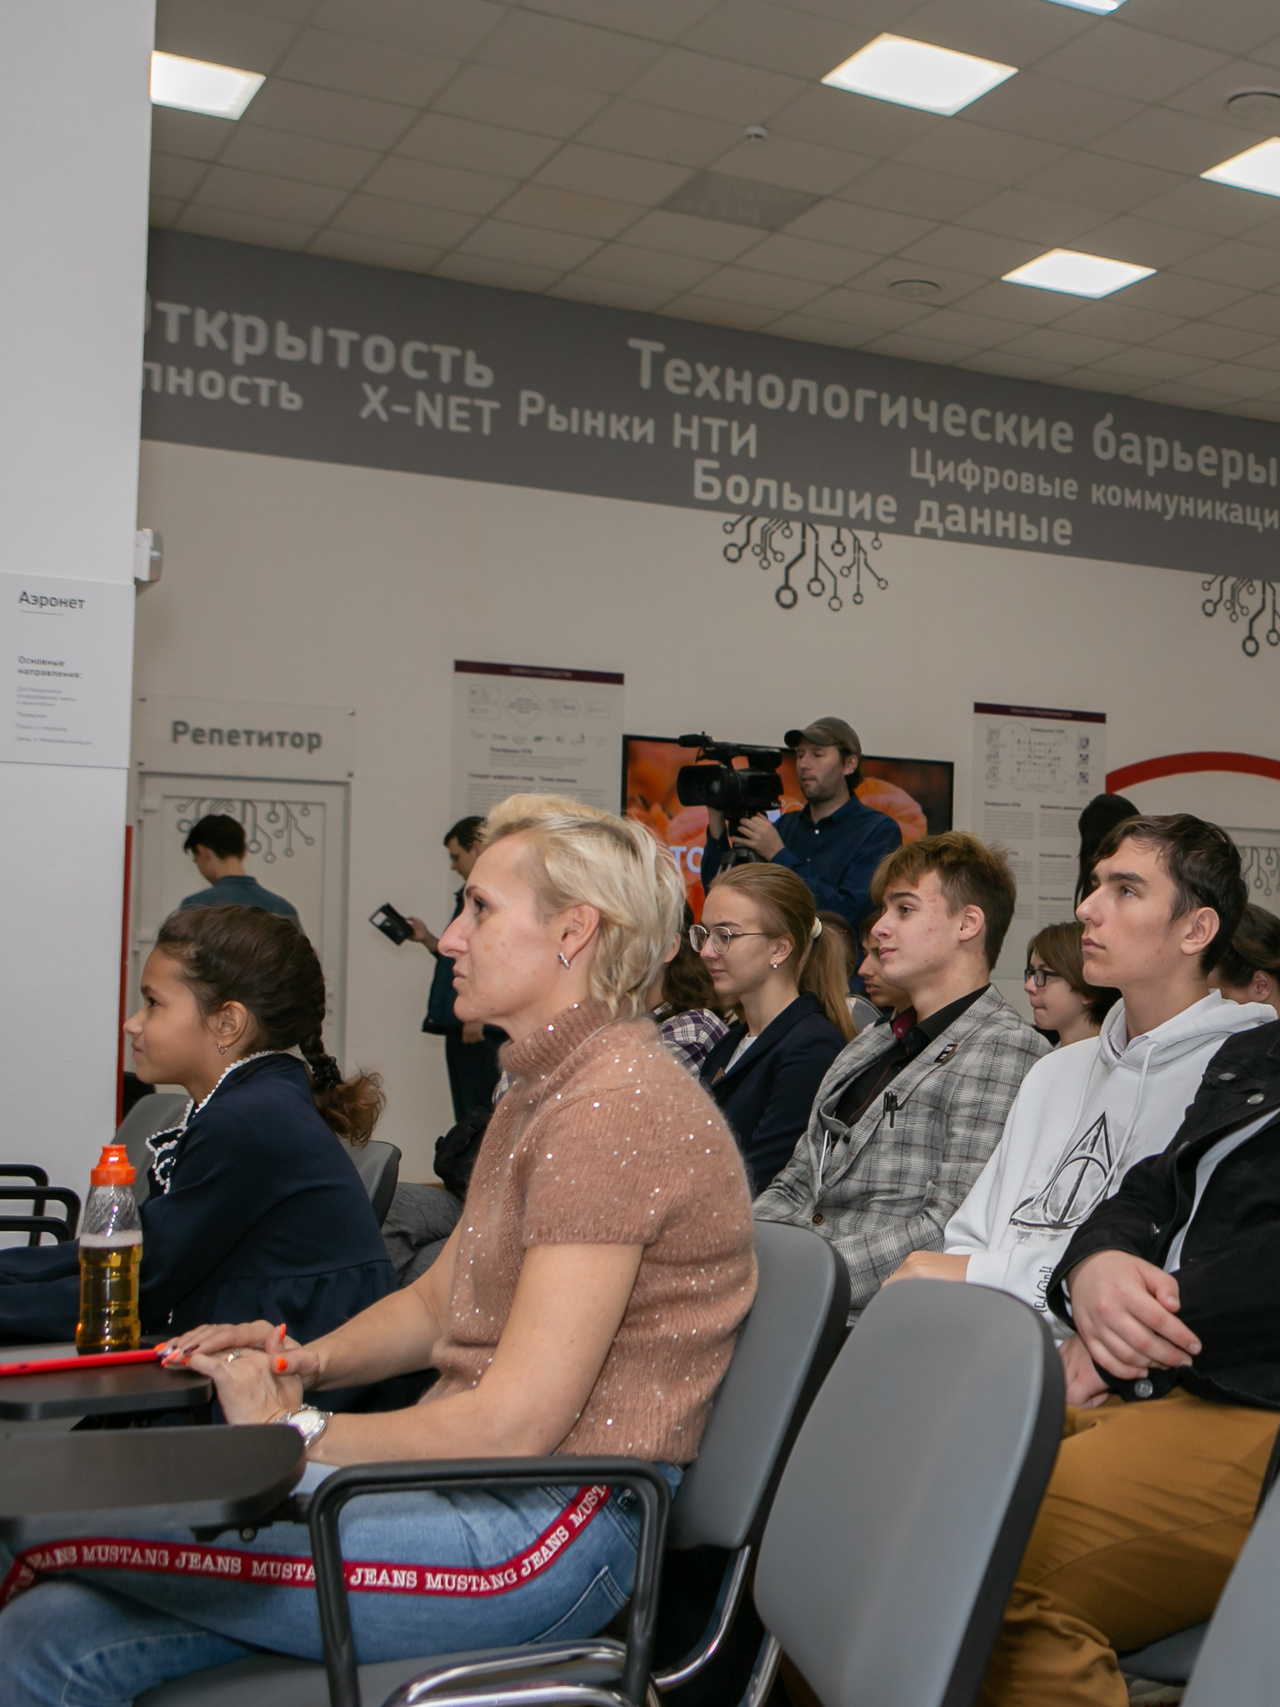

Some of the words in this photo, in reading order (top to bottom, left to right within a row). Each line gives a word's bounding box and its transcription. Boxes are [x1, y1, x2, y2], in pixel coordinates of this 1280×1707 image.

[360, 383, 501, 435] X-NET
[519, 390, 655, 445] Рынки
[672, 413, 757, 458] НТИ
[628, 338, 1074, 453] Технологические
[1093, 412, 1278, 487] барьеры
[694, 459, 897, 523] Большие
[915, 499, 1073, 546] данные
[910, 447, 1078, 501] Цифровые
[18, 590, 87, 610] Аэронет
[171, 720, 322, 754] Репетитор
[82, 1544, 170, 1567] MUSTANG
[175, 1551, 242, 1575] JEANS
[251, 1560, 316, 1581] MUSTA
[350, 1568, 417, 1588] JEANS
[425, 1568, 518, 1592] MUSTANG
[520, 1525, 570, 1577] JEANS
[568, 1485, 607, 1528] MUST
